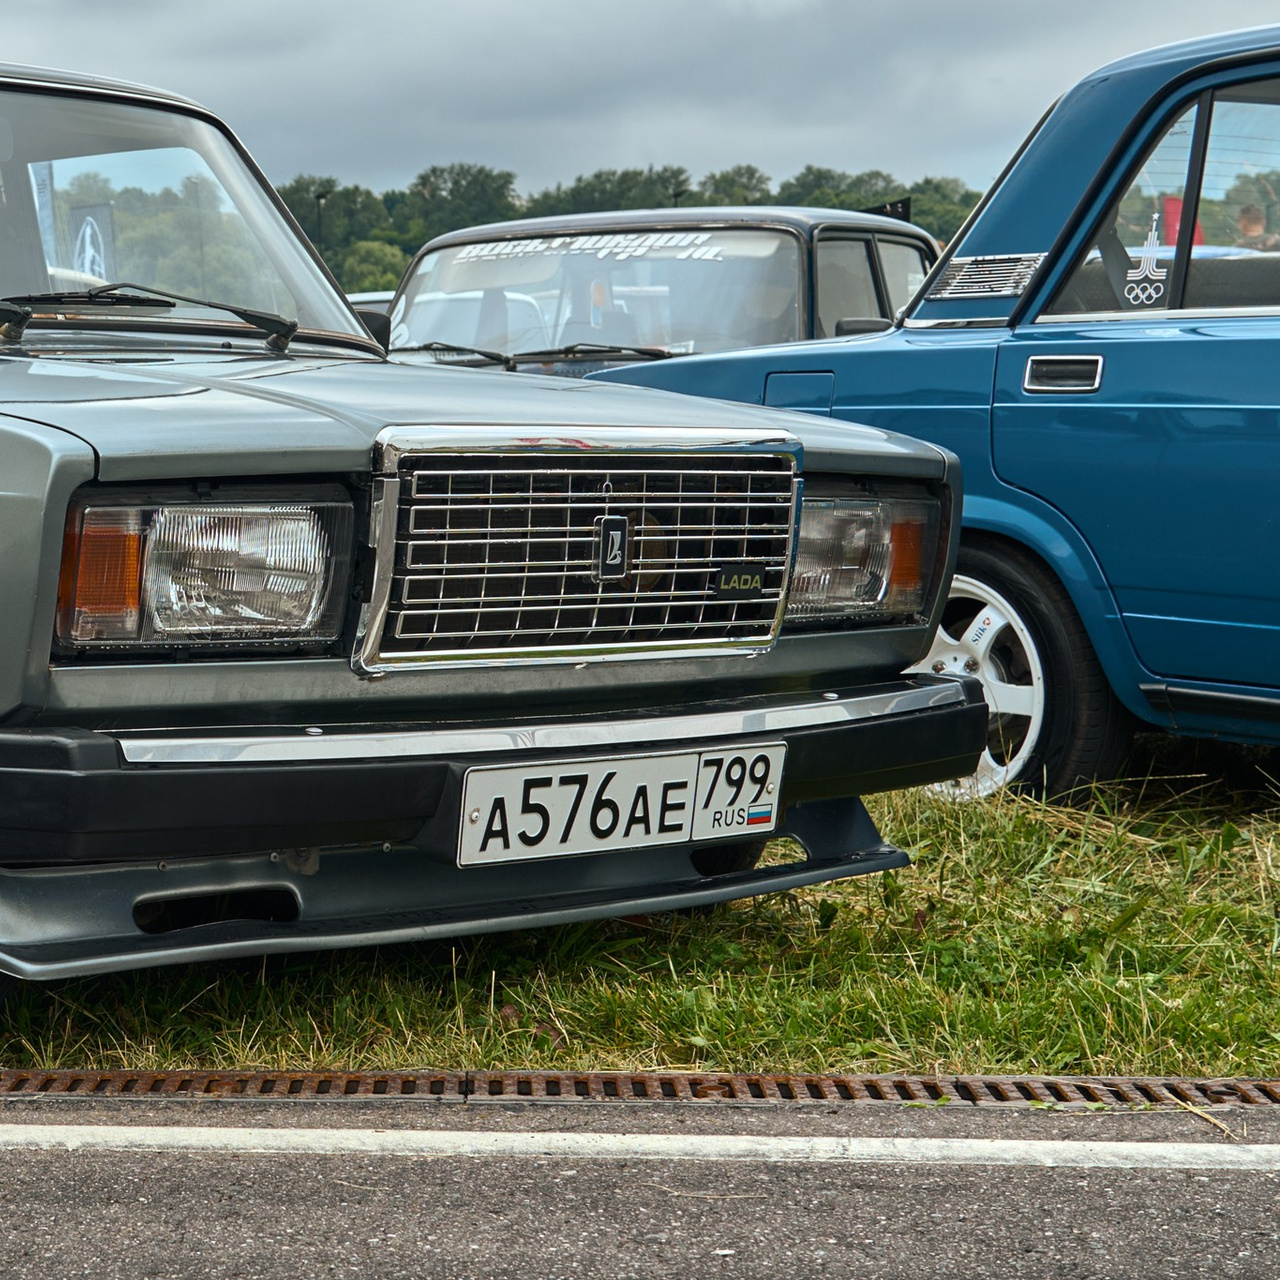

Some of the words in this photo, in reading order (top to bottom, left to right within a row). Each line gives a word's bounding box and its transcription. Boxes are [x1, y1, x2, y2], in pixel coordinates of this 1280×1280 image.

[720, 574, 762, 590] LADA
[702, 754, 771, 810] 799
[711, 808, 746, 829] RUS
